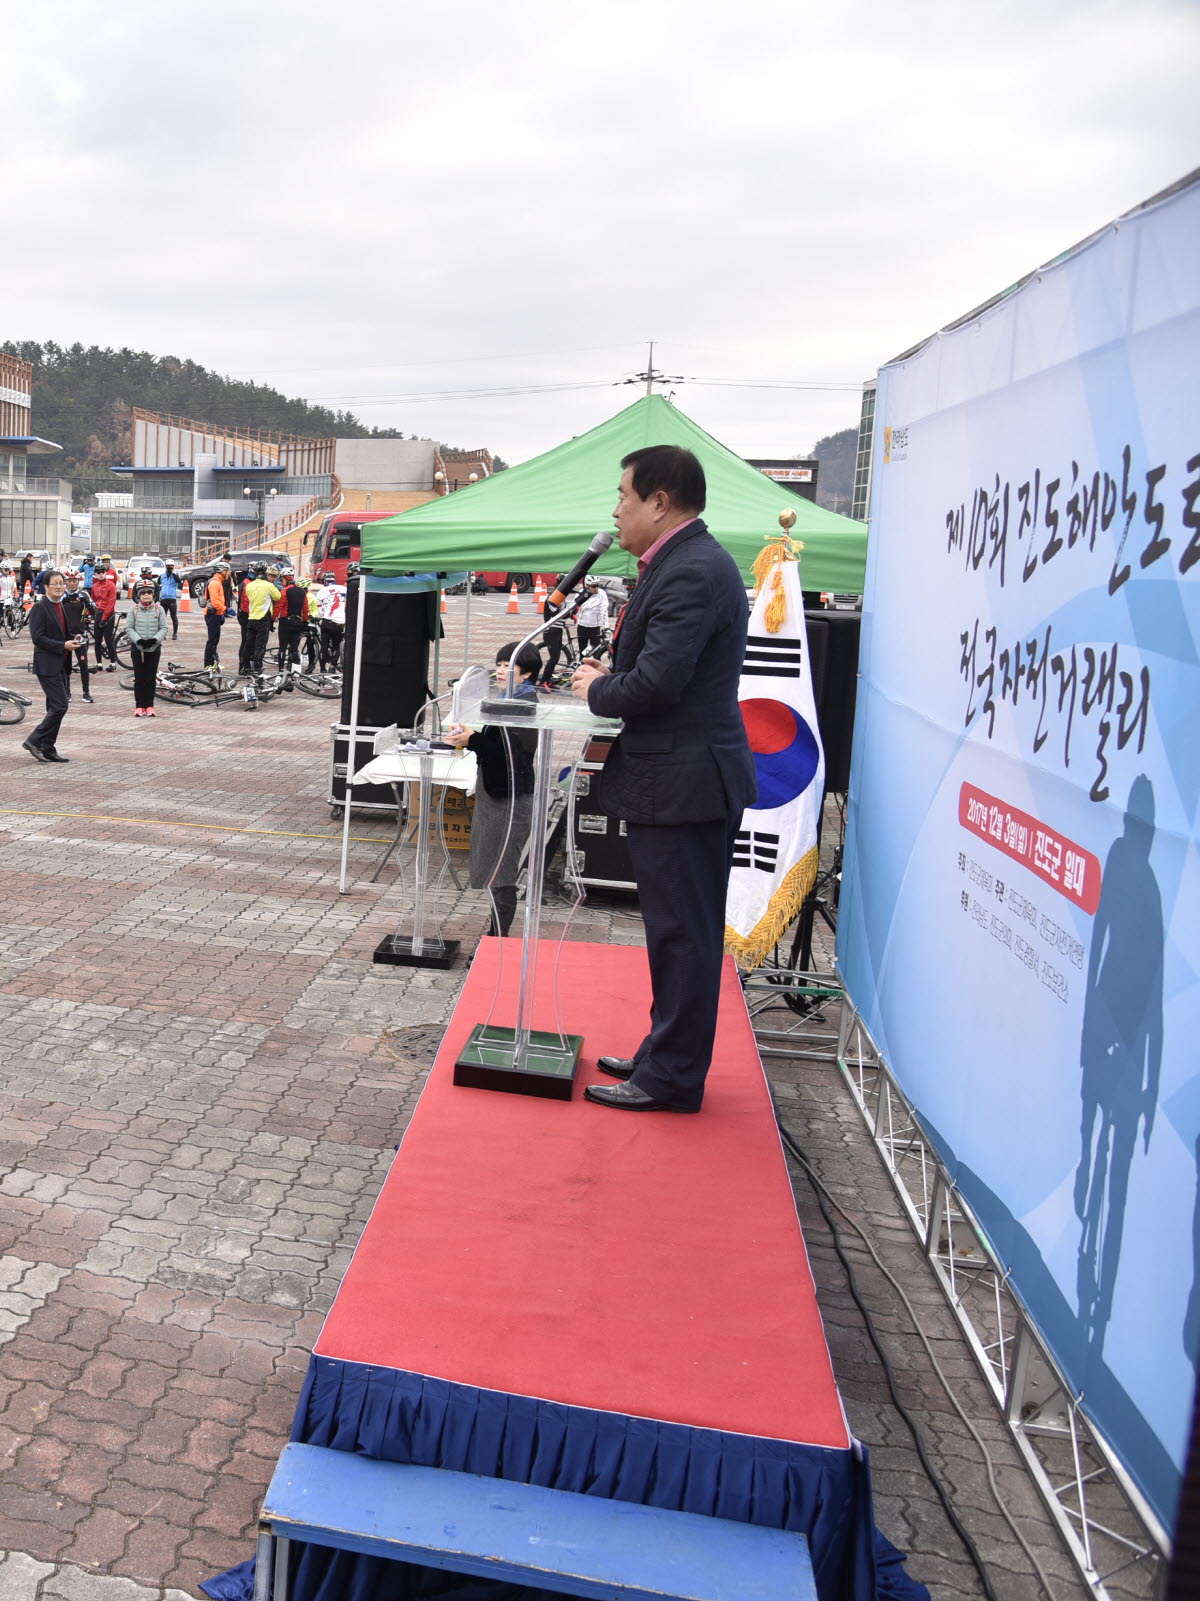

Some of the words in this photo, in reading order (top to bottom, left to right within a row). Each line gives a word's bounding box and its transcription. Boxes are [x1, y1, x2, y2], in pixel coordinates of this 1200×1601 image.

[892, 427, 909, 450] 전라남도
[947, 472, 1009, 588] 제10회
[967, 797, 988, 832] 2017년
[989, 805, 1003, 841] 12월
[1004, 812, 1028, 855] 3일(일)
[1034, 829, 1062, 881] 진도군
[1063, 849, 1086, 897] 일대
